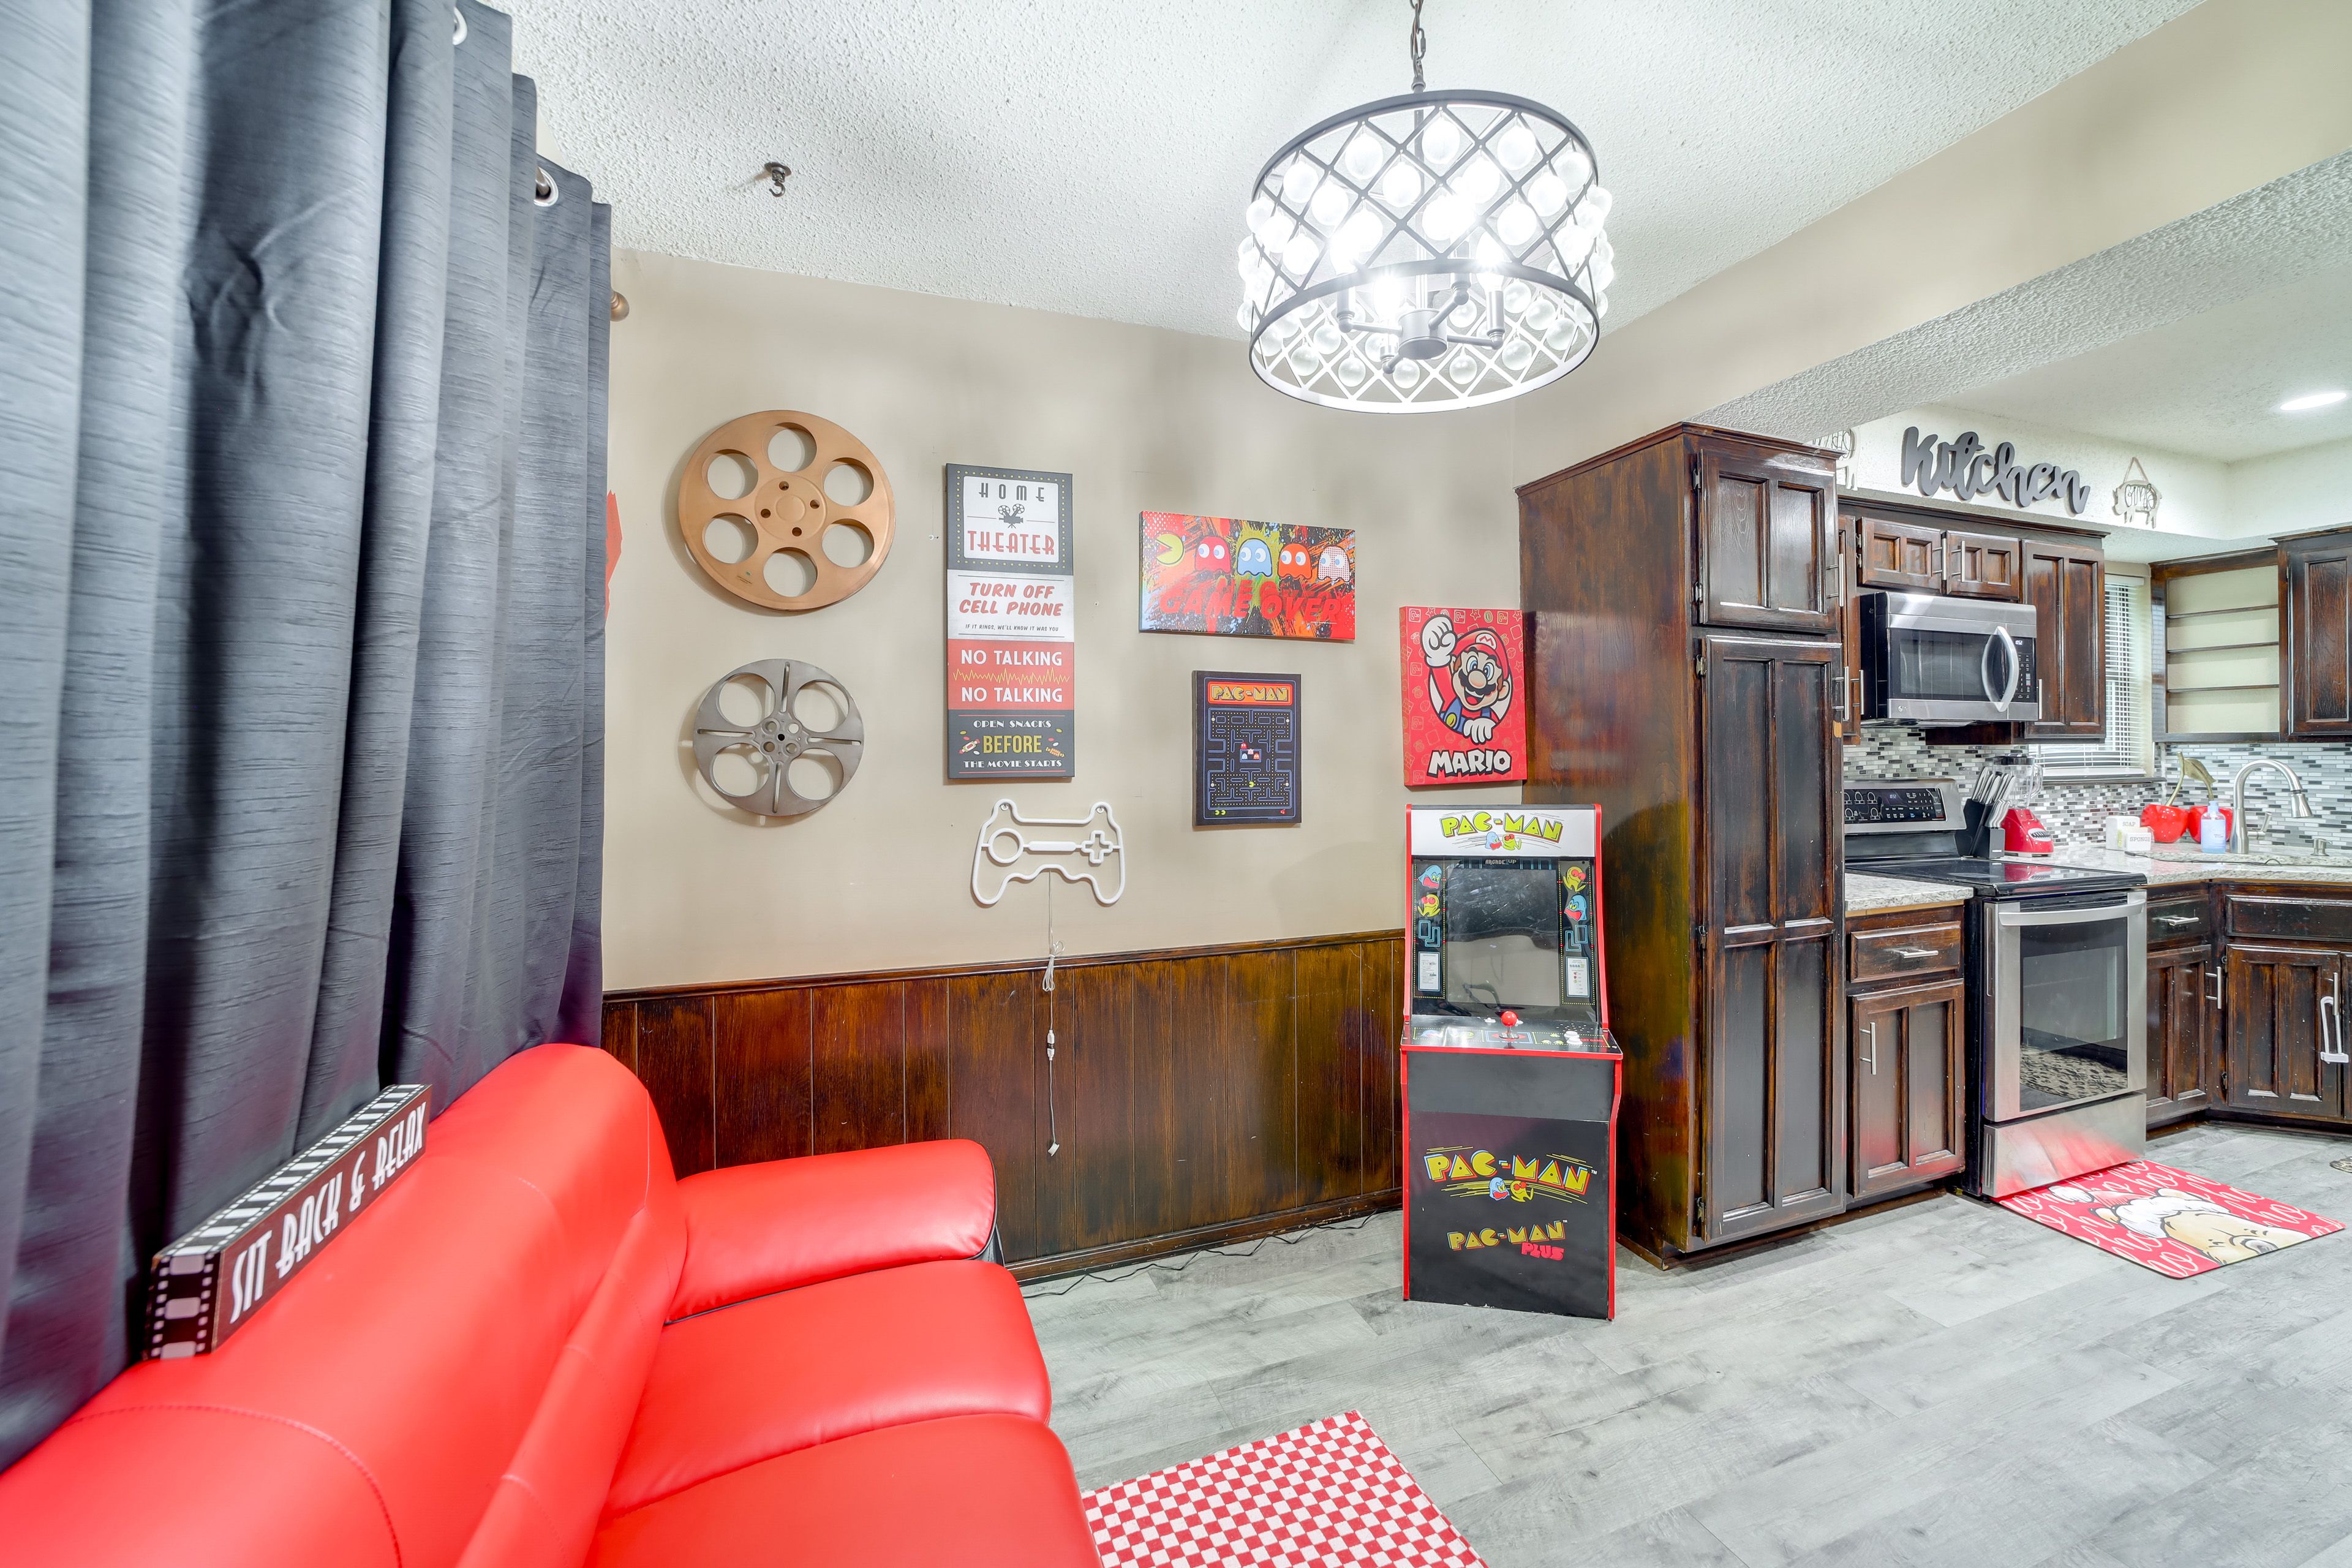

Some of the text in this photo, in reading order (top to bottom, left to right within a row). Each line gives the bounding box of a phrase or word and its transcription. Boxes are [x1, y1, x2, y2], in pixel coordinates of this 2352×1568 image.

[1900, 426, 2091, 514] Kitchen
[978, 482, 1044, 502] HOME
[967, 530, 1055, 555] THEATER
[970, 582, 1055, 599] TURN OFF
[959, 599, 1064, 617] CELL PHONE
[1159, 586, 1252, 618] GAME
[1260, 594, 1341, 621] OVER
[961, 649, 1062, 666] NO TALKING
[961, 687, 1063, 703] NO TALKING
[1212, 685, 1289, 701] PAC-MAN
[982, 735, 1042, 753] BEFORE
[1427, 747, 1512, 778] MARIO
[1439, 811, 1564, 843] PAC-MAN
[1423, 1150, 1591, 1195] PAC-MAN
[230, 1101, 427, 1324] SIT BACK & RELAX
[1447, 1221, 1566, 1251] PAC-MAN
[1521, 1242, 1565, 1261] PLUS
